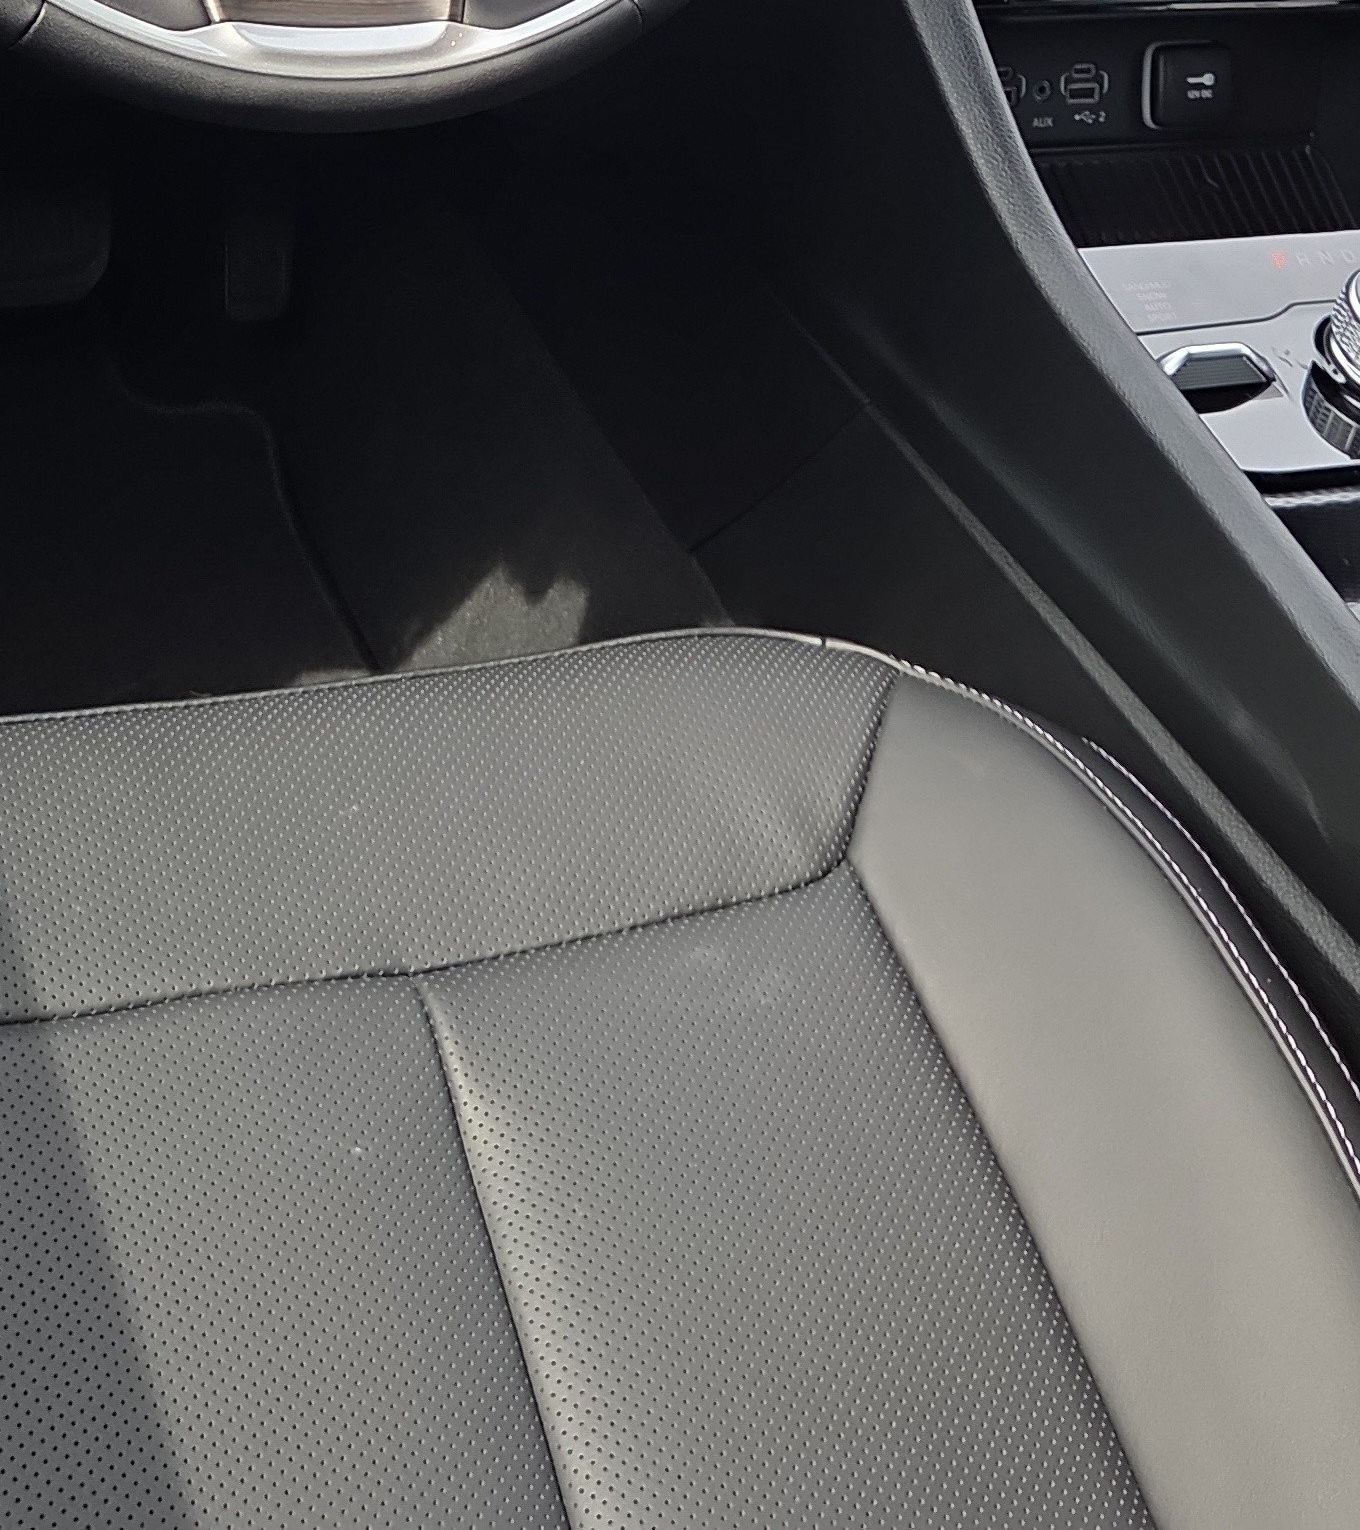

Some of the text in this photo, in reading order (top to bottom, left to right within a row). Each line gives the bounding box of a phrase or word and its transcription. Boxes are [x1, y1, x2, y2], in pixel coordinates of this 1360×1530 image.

[1032, 117, 1054, 128] AUX
[1318, 250, 1336, 266] N
[1339, 248, 1357, 264] D
